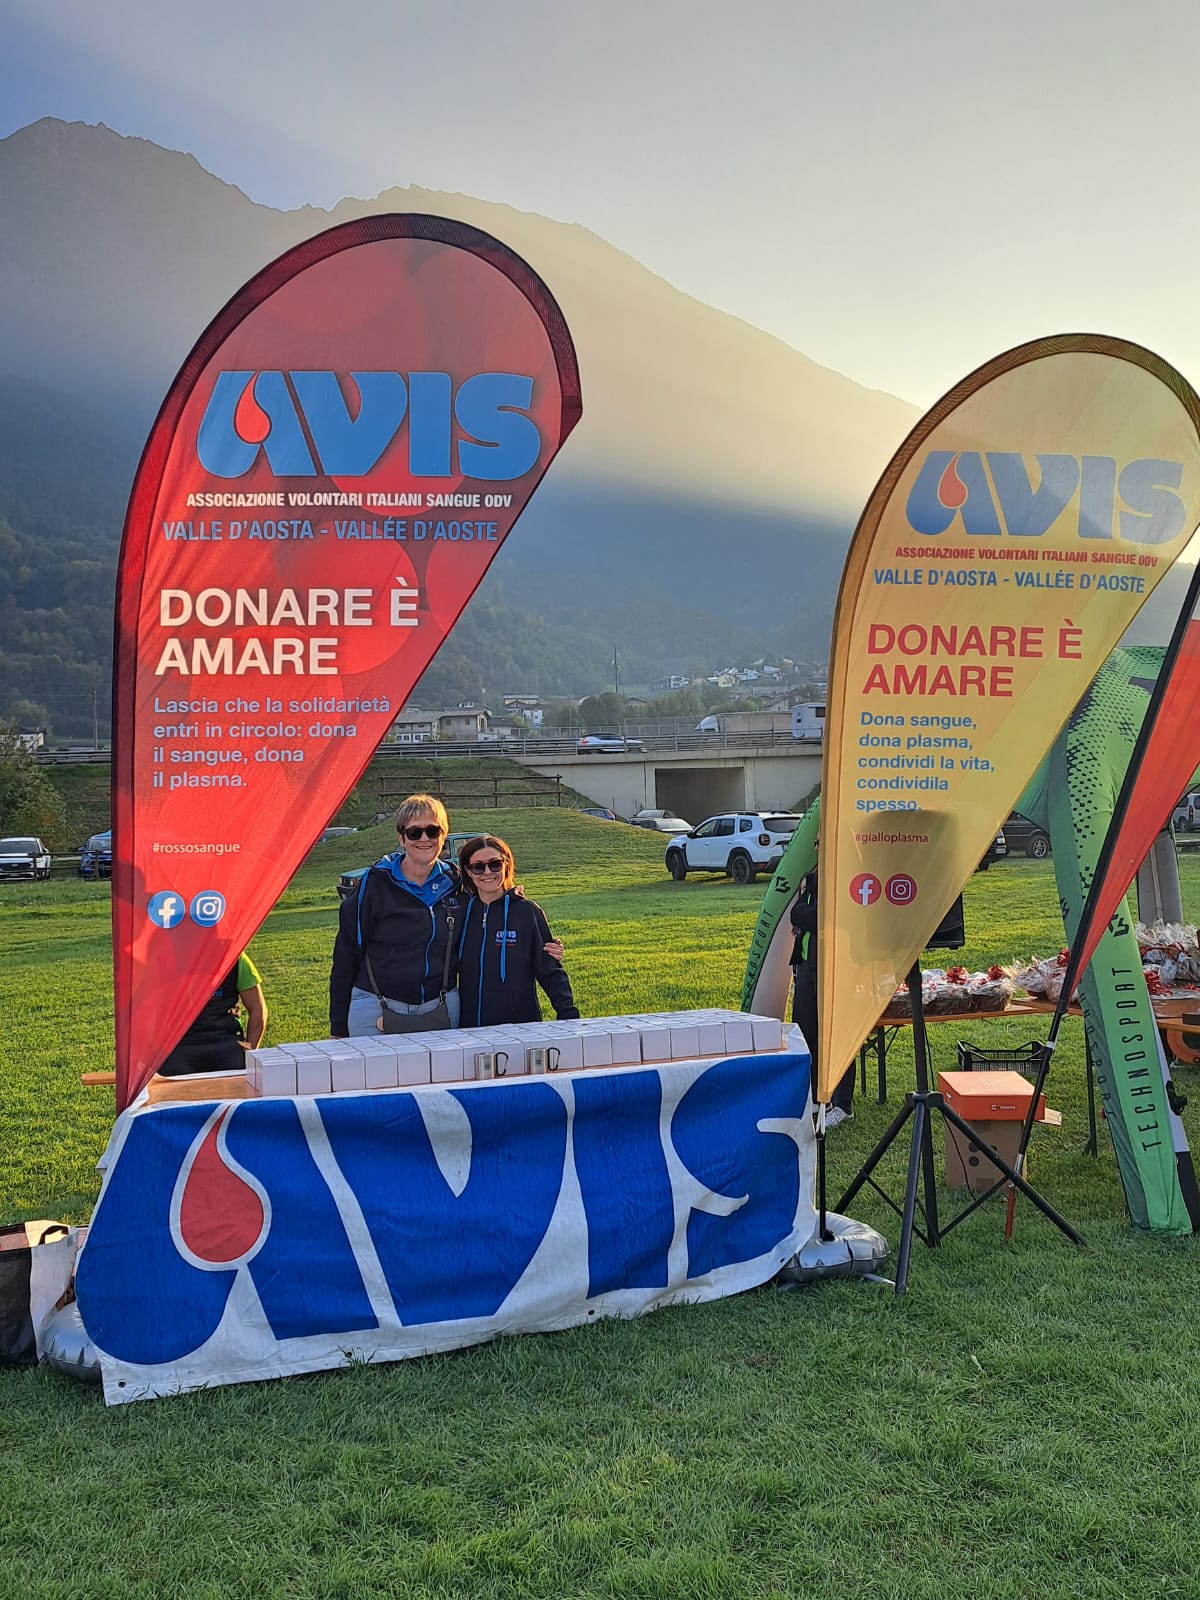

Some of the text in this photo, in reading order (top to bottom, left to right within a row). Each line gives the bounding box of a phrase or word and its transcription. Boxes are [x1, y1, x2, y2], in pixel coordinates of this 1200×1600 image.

[196, 370, 541, 480] AVIS
[186, 493, 512, 507] ASSOCIAZIONE VOLONTARI ITALIANI SANGUE ODV
[905, 450, 1187, 544] AVIS
[163, 521, 223, 541] VALLE
[228, 520, 315, 541] D'AOSTA
[334, 516, 407, 540] VALLÉE
[413, 520, 498, 541] D'AOSTE
[895, 546, 1159, 568] ASSOCIAZIONE VOLONTARI ITALIANI SANGUE ODV
[873, 568, 924, 585] VALLE
[927, 569, 998, 587] D'AOSTA
[1014, 569, 1075, 589] VALLÉE
[1079, 573, 1146, 594] D'AOSTE
[158, 576, 420, 628] DONARE È
[866, 618, 1083, 659] DONARE È
[154, 637, 339, 676] AMARE
[861, 664, 1015, 698] AMARE
[153, 695, 391, 713] Lascia che la solidarietà
[153, 721, 358, 739] entri in circolo: dona
[860, 711, 978, 731] Dona sangue,
[858, 733, 974, 751] dona plasma,
[152, 746, 305, 766] il sangue, dona
[857, 755, 996, 773] condividi la vita,
[152, 771, 248, 790] il plasma.
[856, 775, 950, 791] condividila
[855, 832, 929, 844] #gialloplasma
[152, 842, 241, 856] #rossosangue
[1111, 967, 1163, 1152] TECHNOSPORT
[75, 1052, 812, 1365] AVIS
